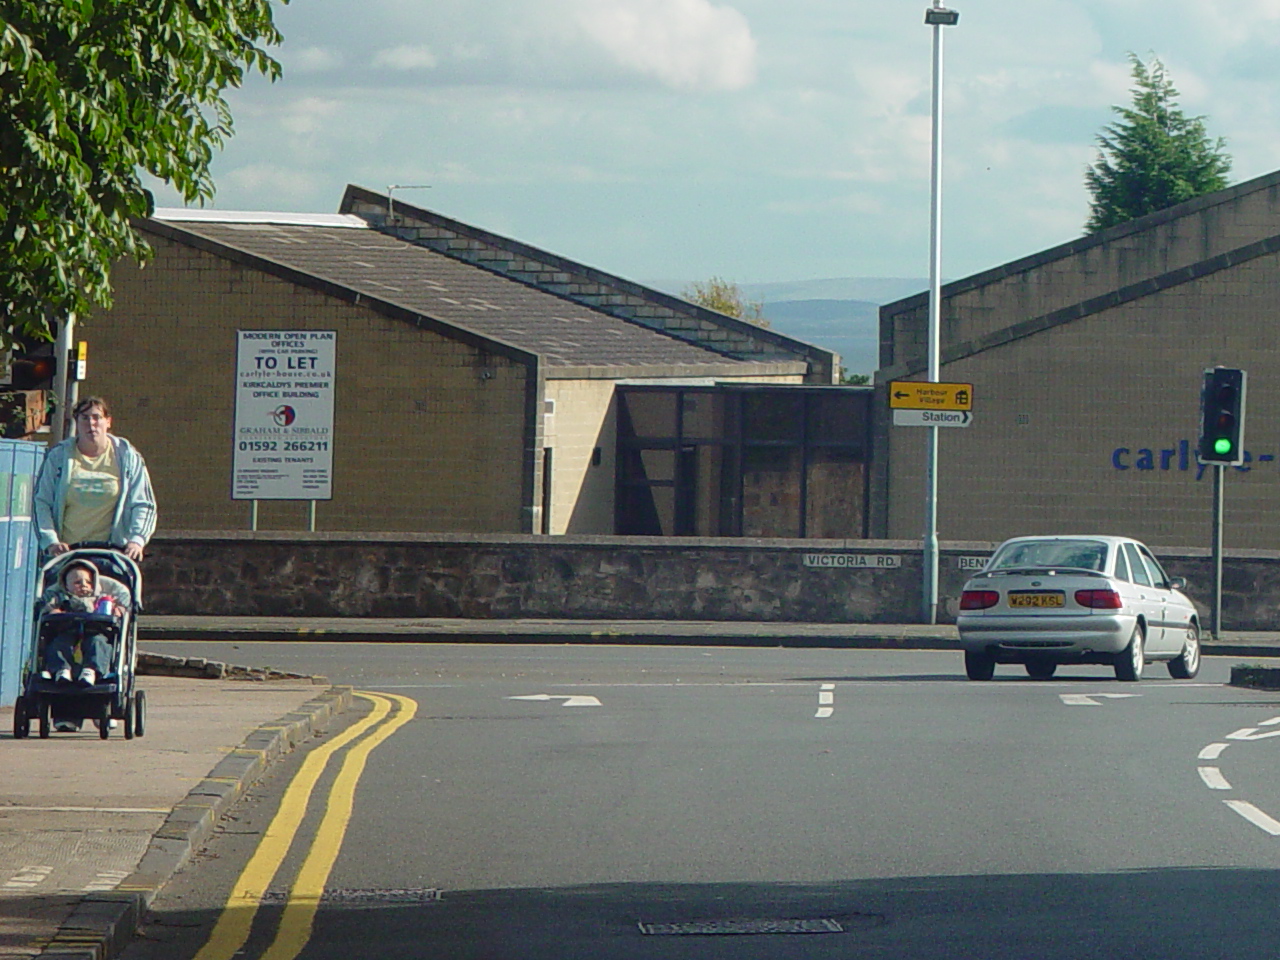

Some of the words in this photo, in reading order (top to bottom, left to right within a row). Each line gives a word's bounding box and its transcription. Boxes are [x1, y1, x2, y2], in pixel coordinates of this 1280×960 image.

[271, 340, 305, 348] OFFICES
[254, 356, 277, 370] TO
[287, 356, 318, 370] LET
[922, 411, 960, 422] Station
[239, 441, 277, 451] 01592
[283, 441, 328, 451] 266211
[808, 555, 867, 566] VICTORIA
[877, 556, 896, 566] RD.
[1041, 595, 1062, 606] KSL
